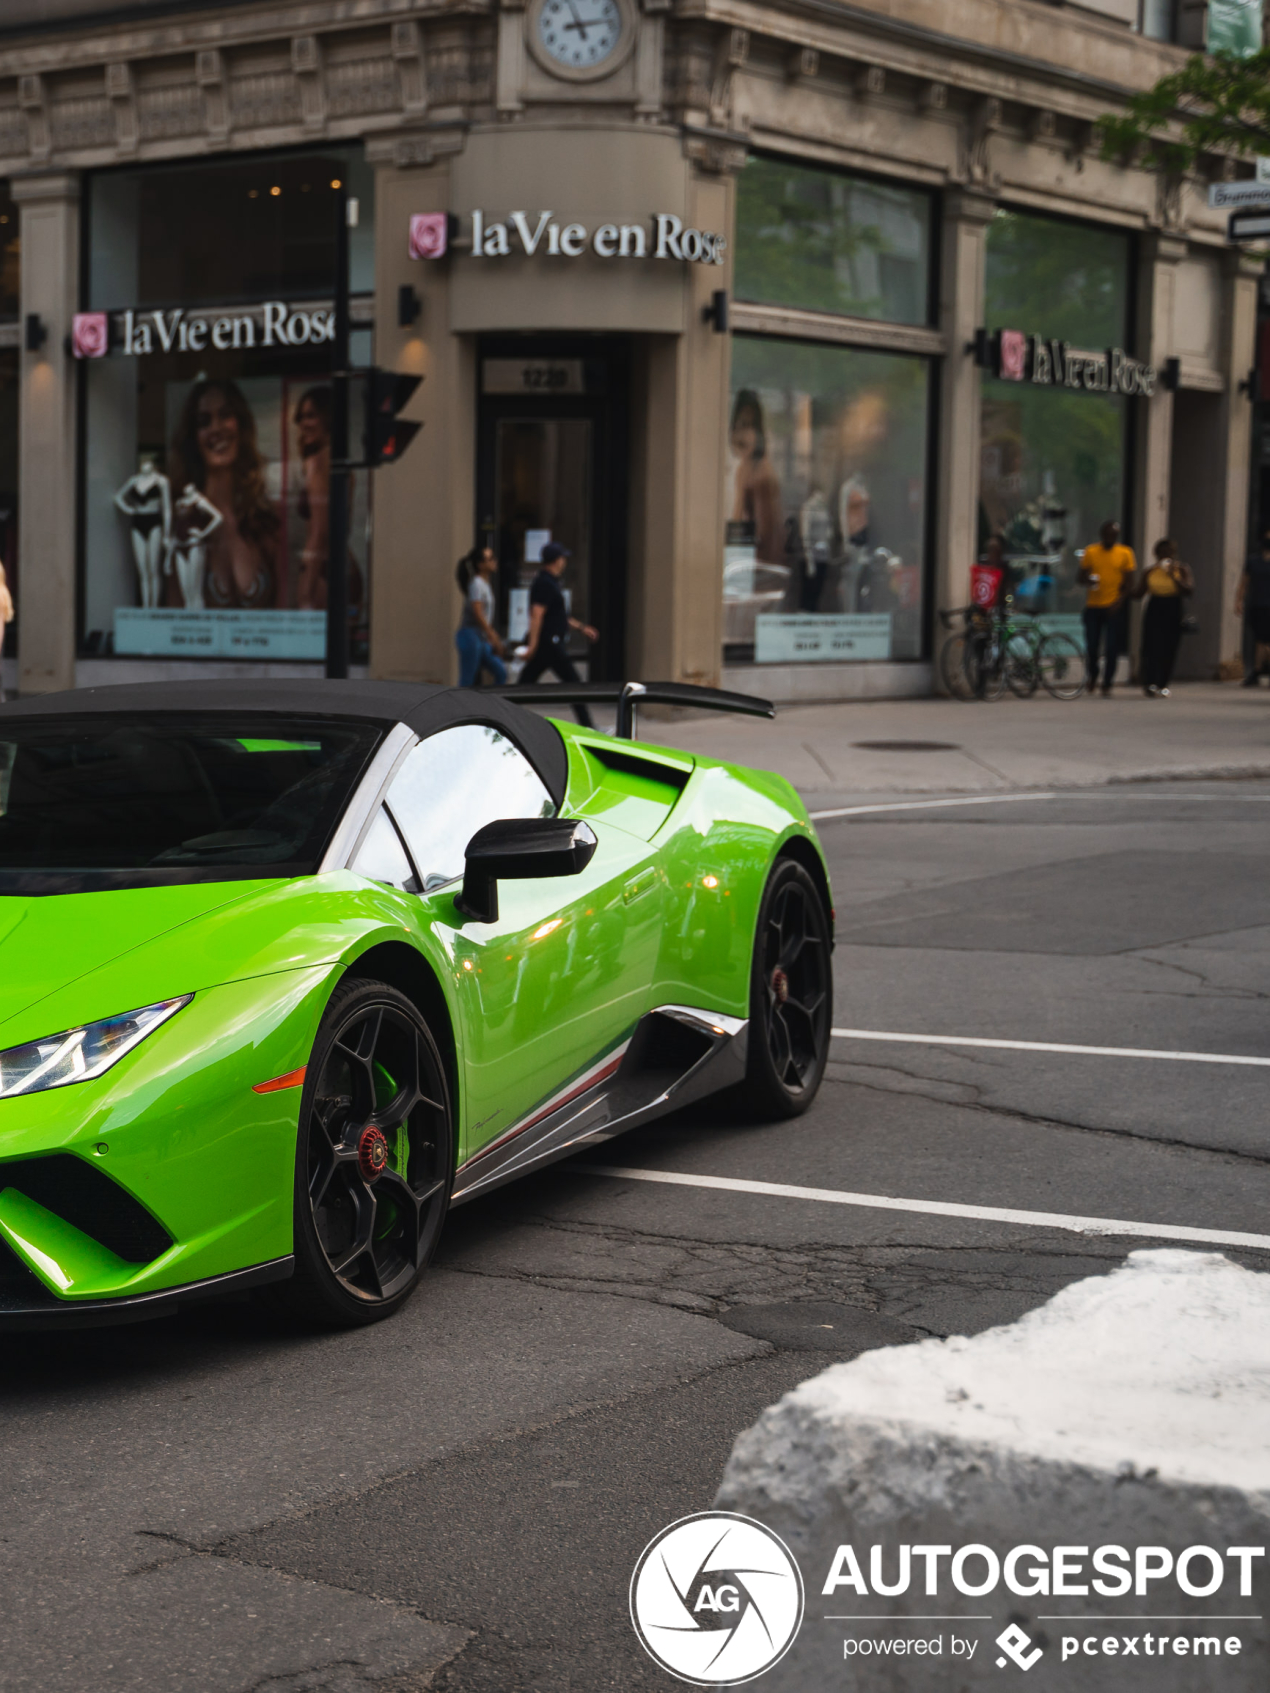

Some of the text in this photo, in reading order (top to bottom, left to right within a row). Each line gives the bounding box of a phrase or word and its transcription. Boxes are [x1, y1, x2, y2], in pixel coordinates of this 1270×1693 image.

[593, 223, 646, 258] en
[654, 212, 727, 266] Rose
[211, 315, 256, 350] en
